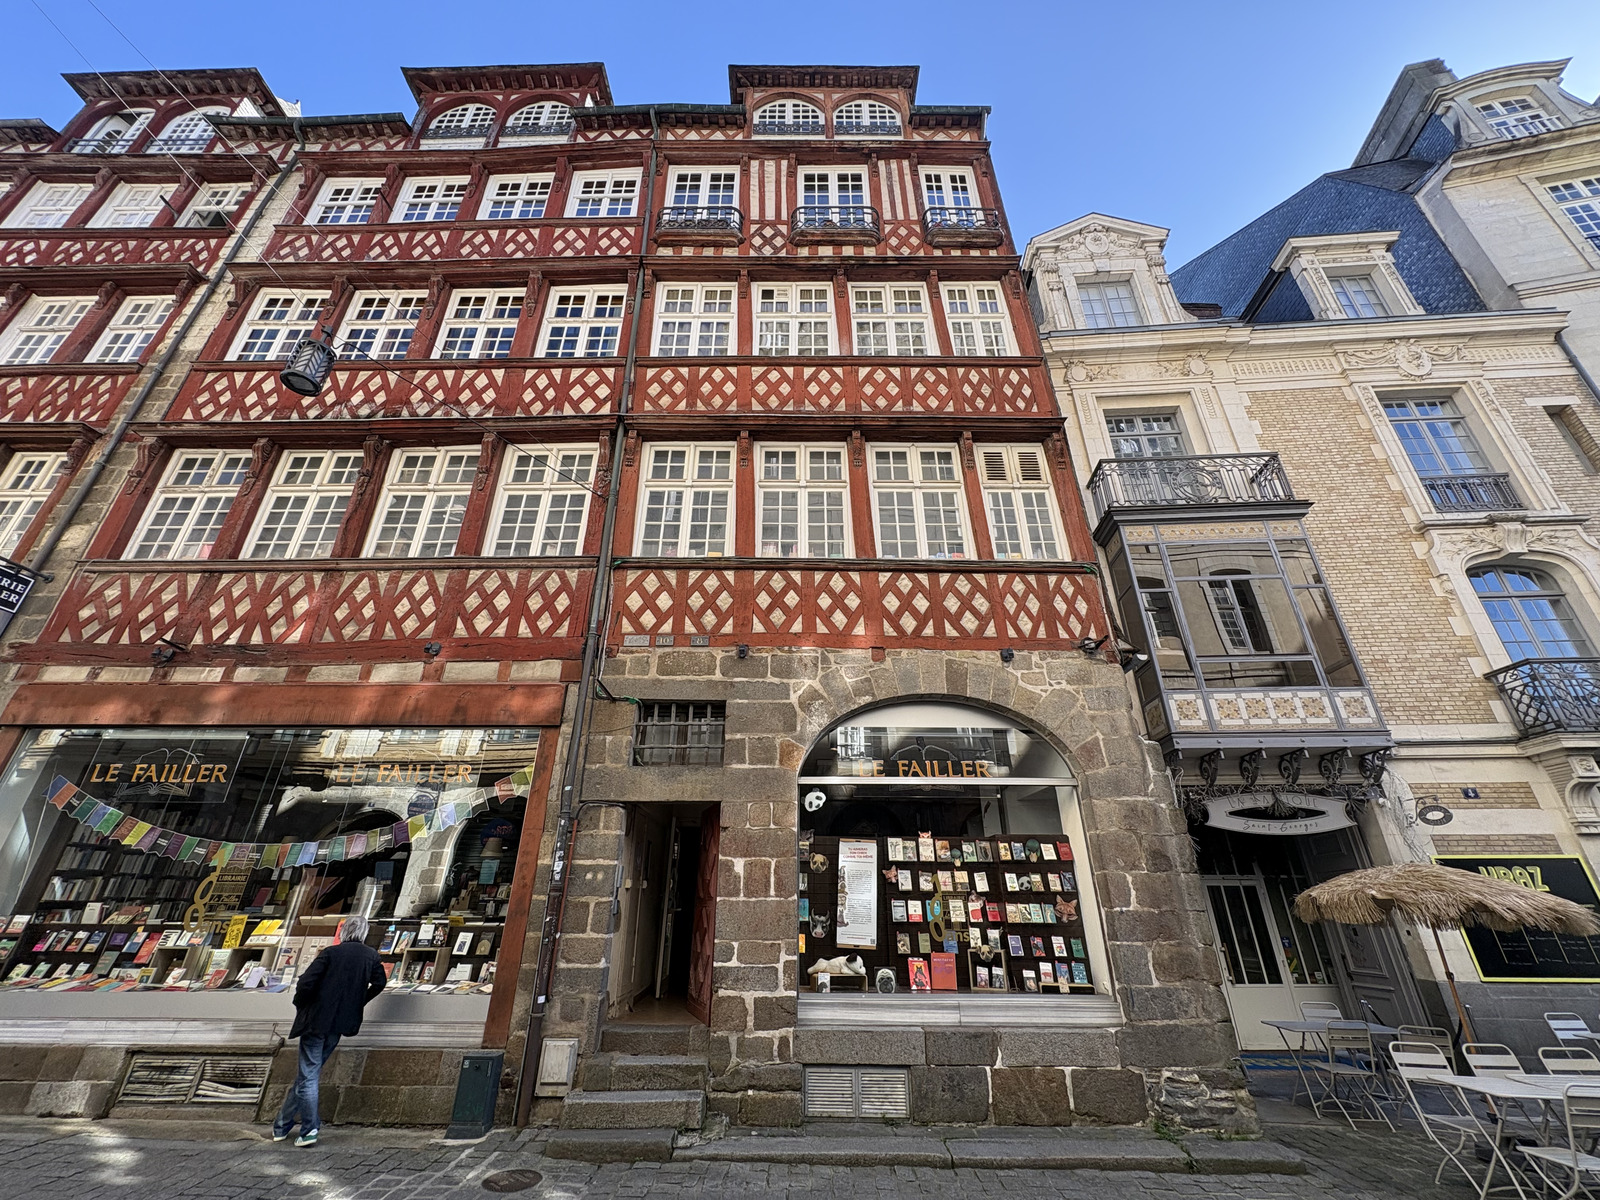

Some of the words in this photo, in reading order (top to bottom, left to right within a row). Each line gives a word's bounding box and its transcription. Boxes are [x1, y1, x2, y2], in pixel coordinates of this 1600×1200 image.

[90, 763, 123, 783] LE
[131, 763, 228, 783] FAILLER
[335, 764, 367, 783] LE
[376, 764, 473, 783] FAILLER
[859, 760, 885, 777] LE
[897, 760, 993, 778] FAILLER
[1468, 789, 1475, 798] 4
[1243, 820, 1319, 833] Saint-Georges
